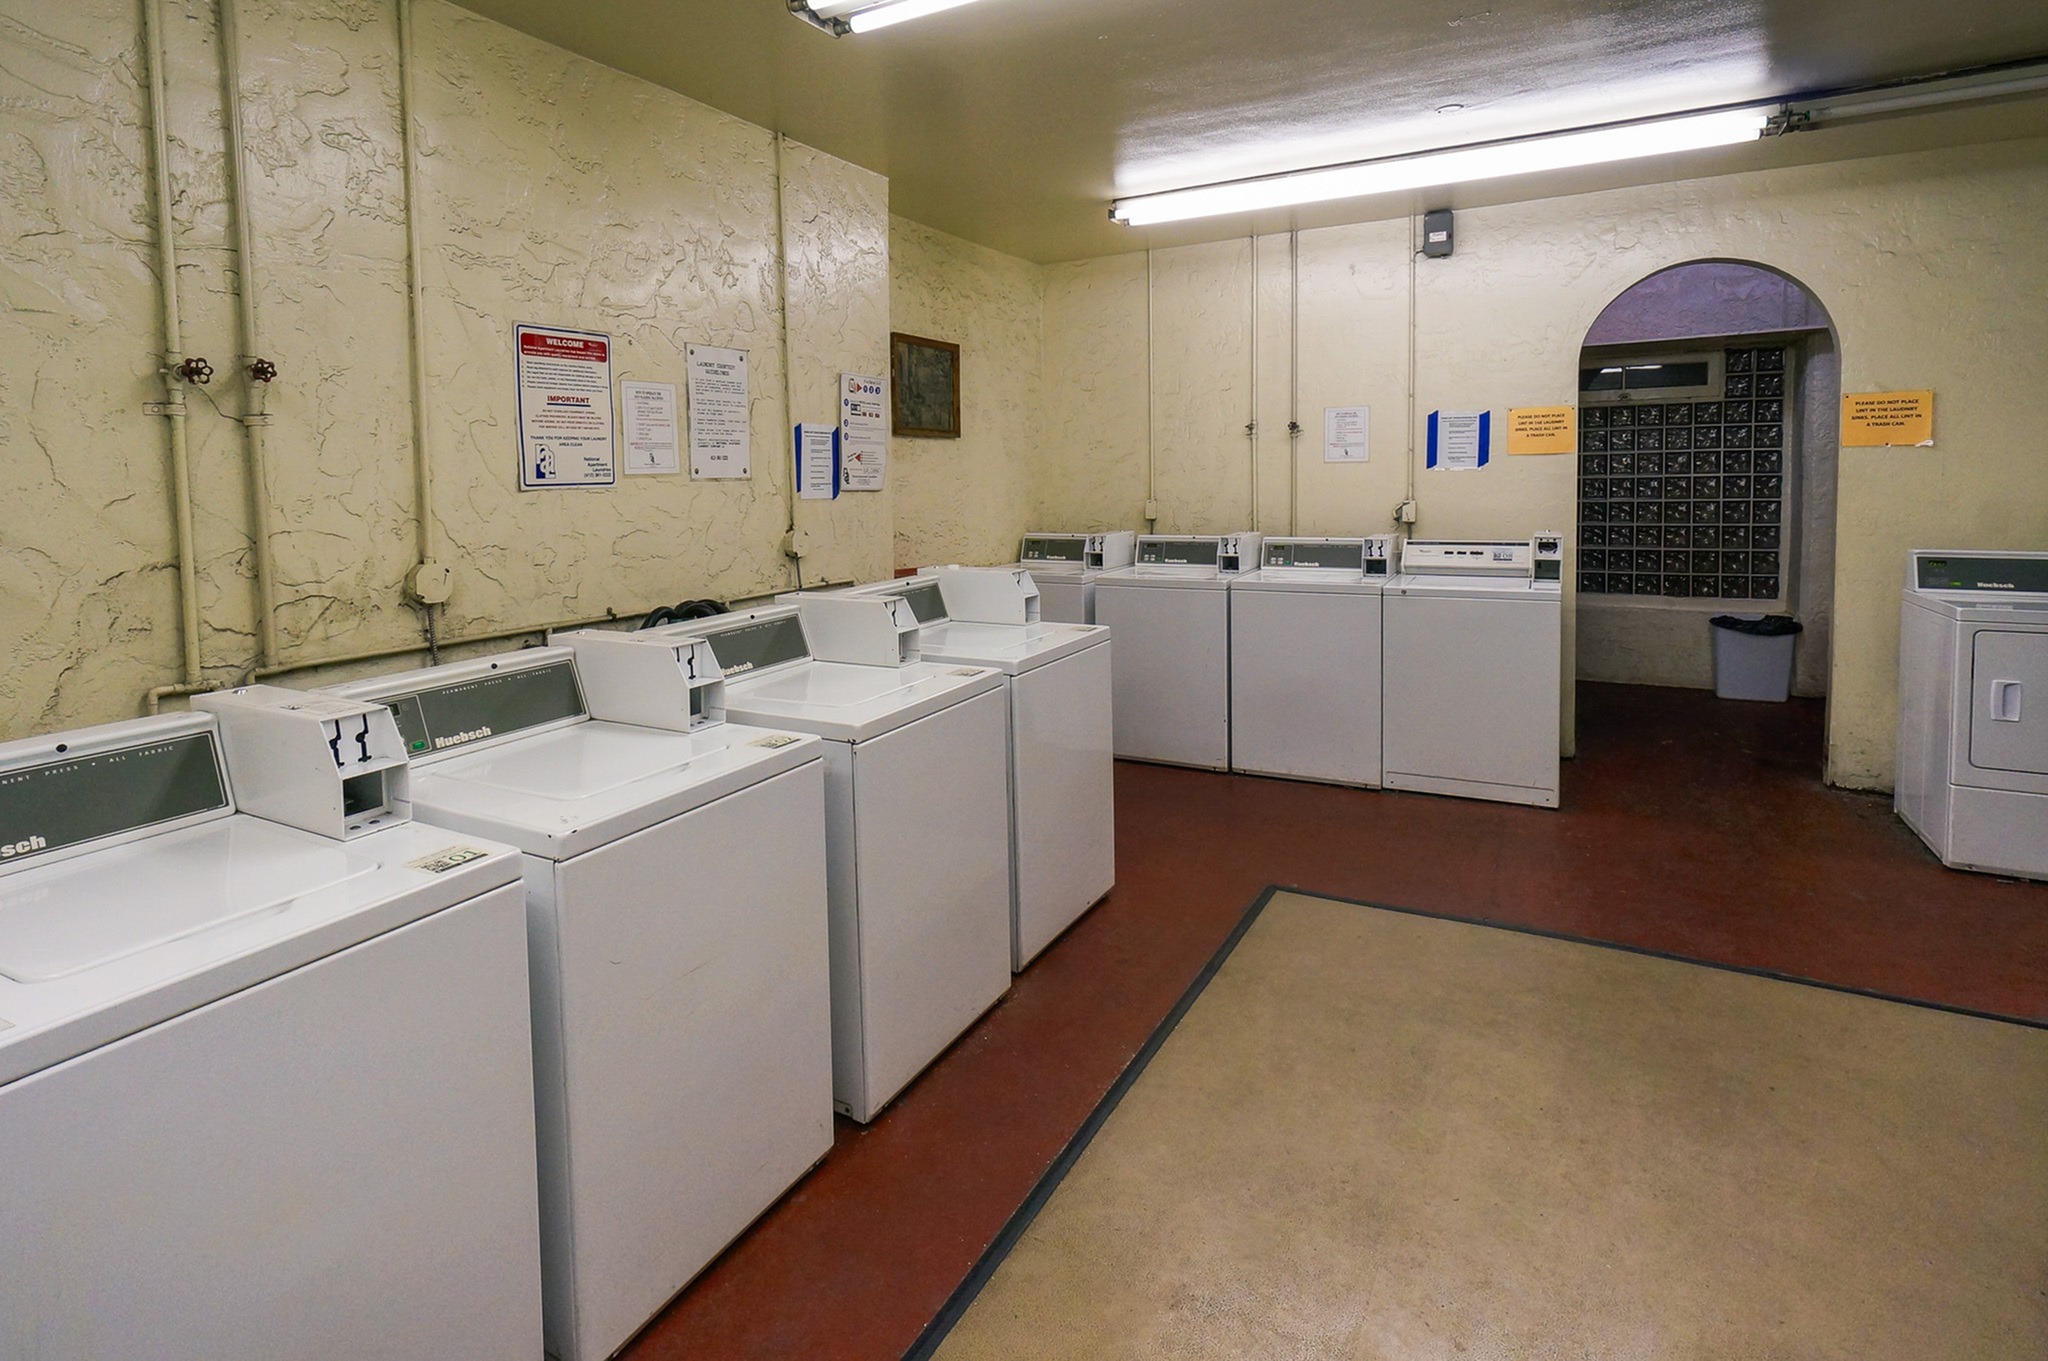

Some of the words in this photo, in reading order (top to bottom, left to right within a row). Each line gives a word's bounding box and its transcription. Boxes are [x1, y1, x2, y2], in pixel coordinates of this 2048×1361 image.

[546, 338, 584, 348] WELCOME
[547, 395, 590, 404] IMPORTANT
[435, 726, 492, 748] Huebsch
[44, 764, 79, 776] PRESS
[108, 755, 127, 763] ALL
[138, 745, 175, 757] FABRIC
